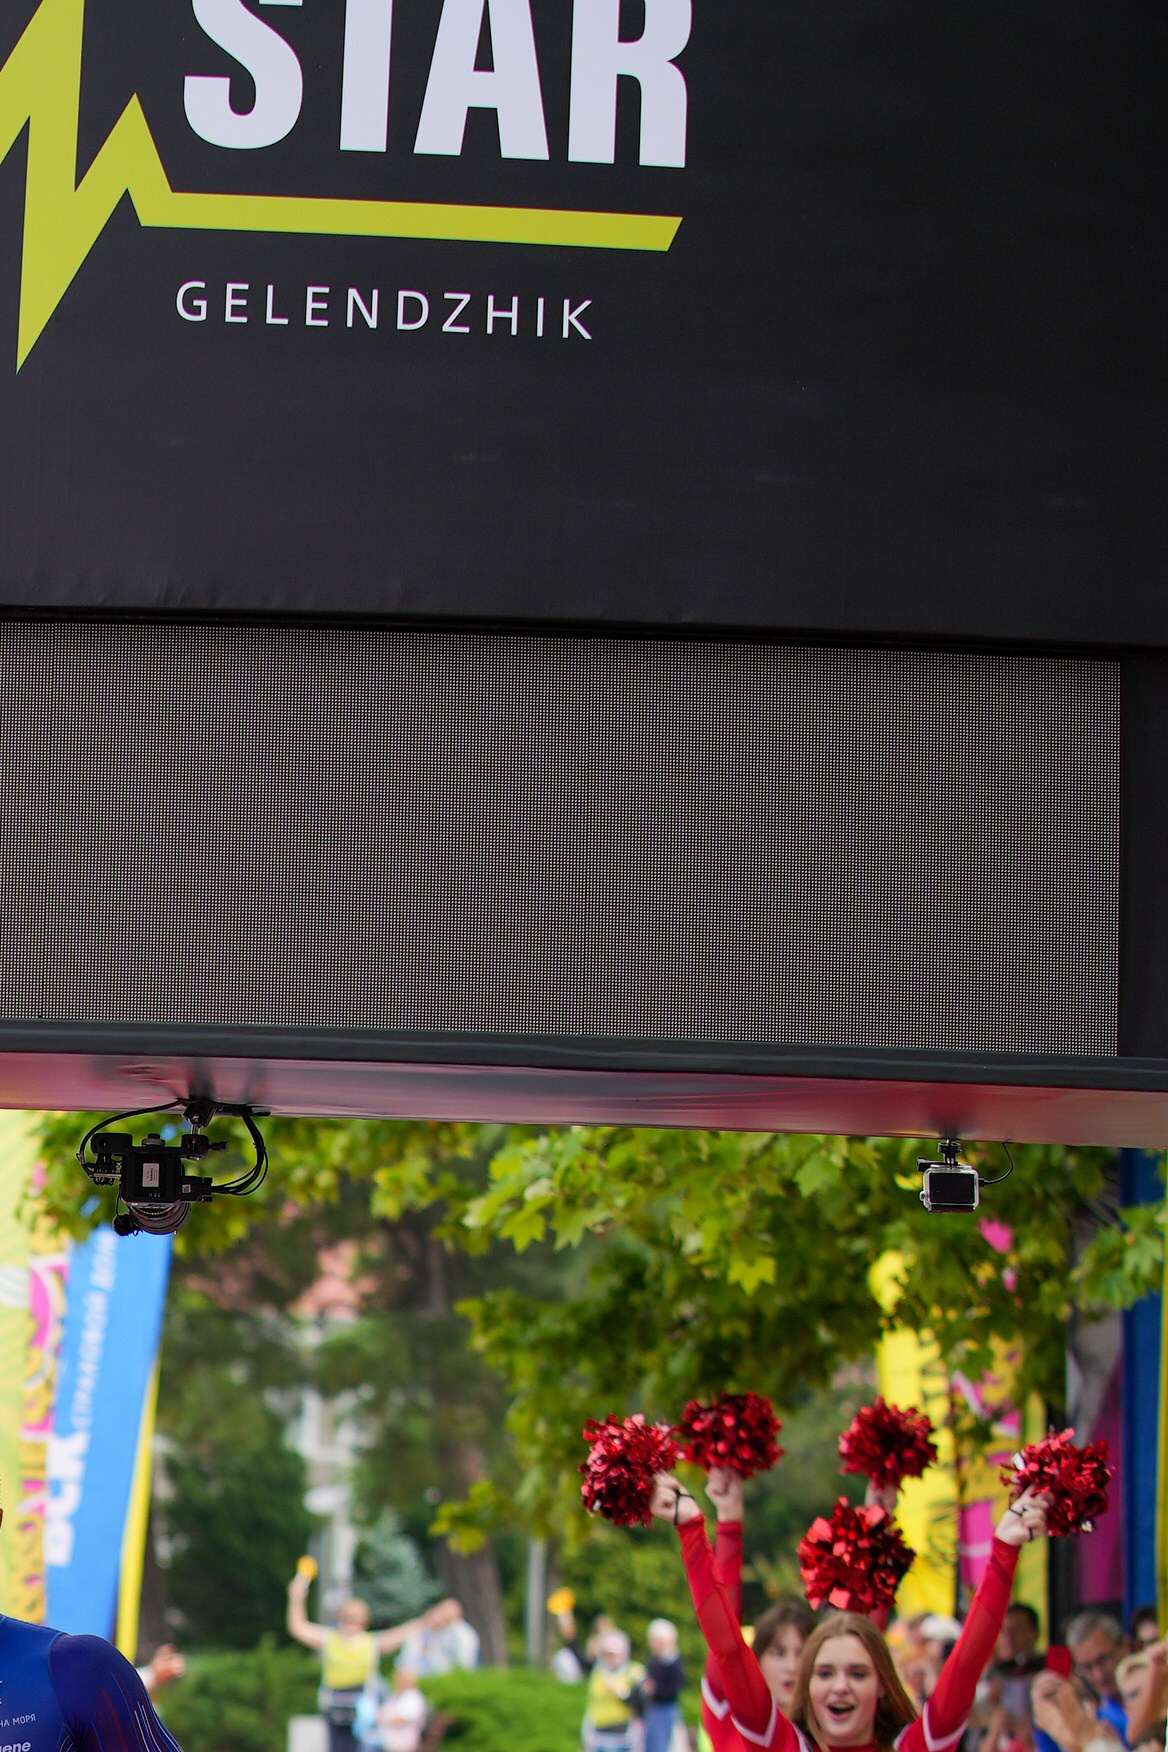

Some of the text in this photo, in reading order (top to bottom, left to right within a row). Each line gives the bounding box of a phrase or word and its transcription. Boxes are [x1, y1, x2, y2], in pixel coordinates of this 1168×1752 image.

[183, 0, 692, 168] STAR
[176, 281, 595, 340] GELENDZHIK
[12, 1713, 36, 1726] МОРЯ
